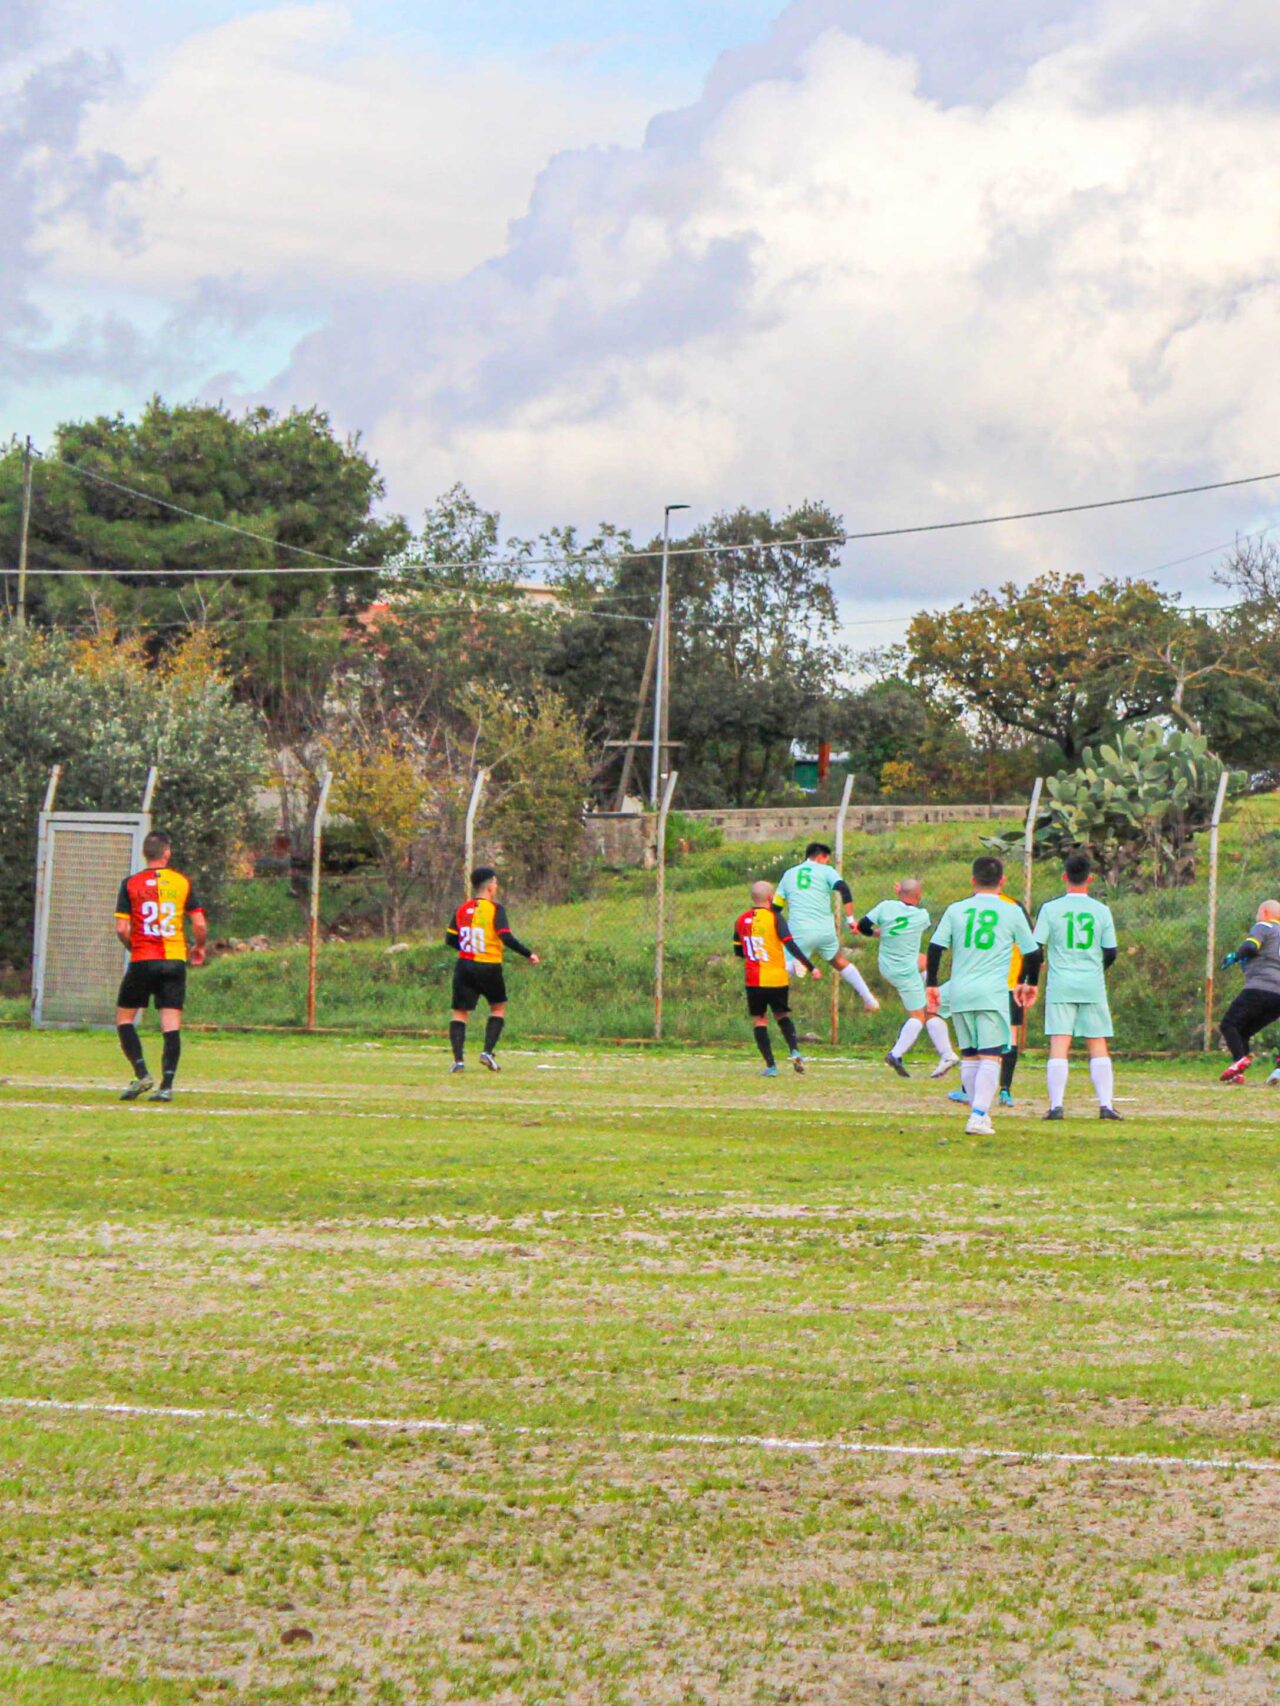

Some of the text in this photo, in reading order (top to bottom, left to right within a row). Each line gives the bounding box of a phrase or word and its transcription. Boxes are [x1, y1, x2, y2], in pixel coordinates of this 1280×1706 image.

[797, 867, 812, 889] 6
[141, 901, 176, 937] 22
[888, 916, 909, 936] 2
[963, 908, 998, 950] 18
[1061, 911, 1094, 950] 13
